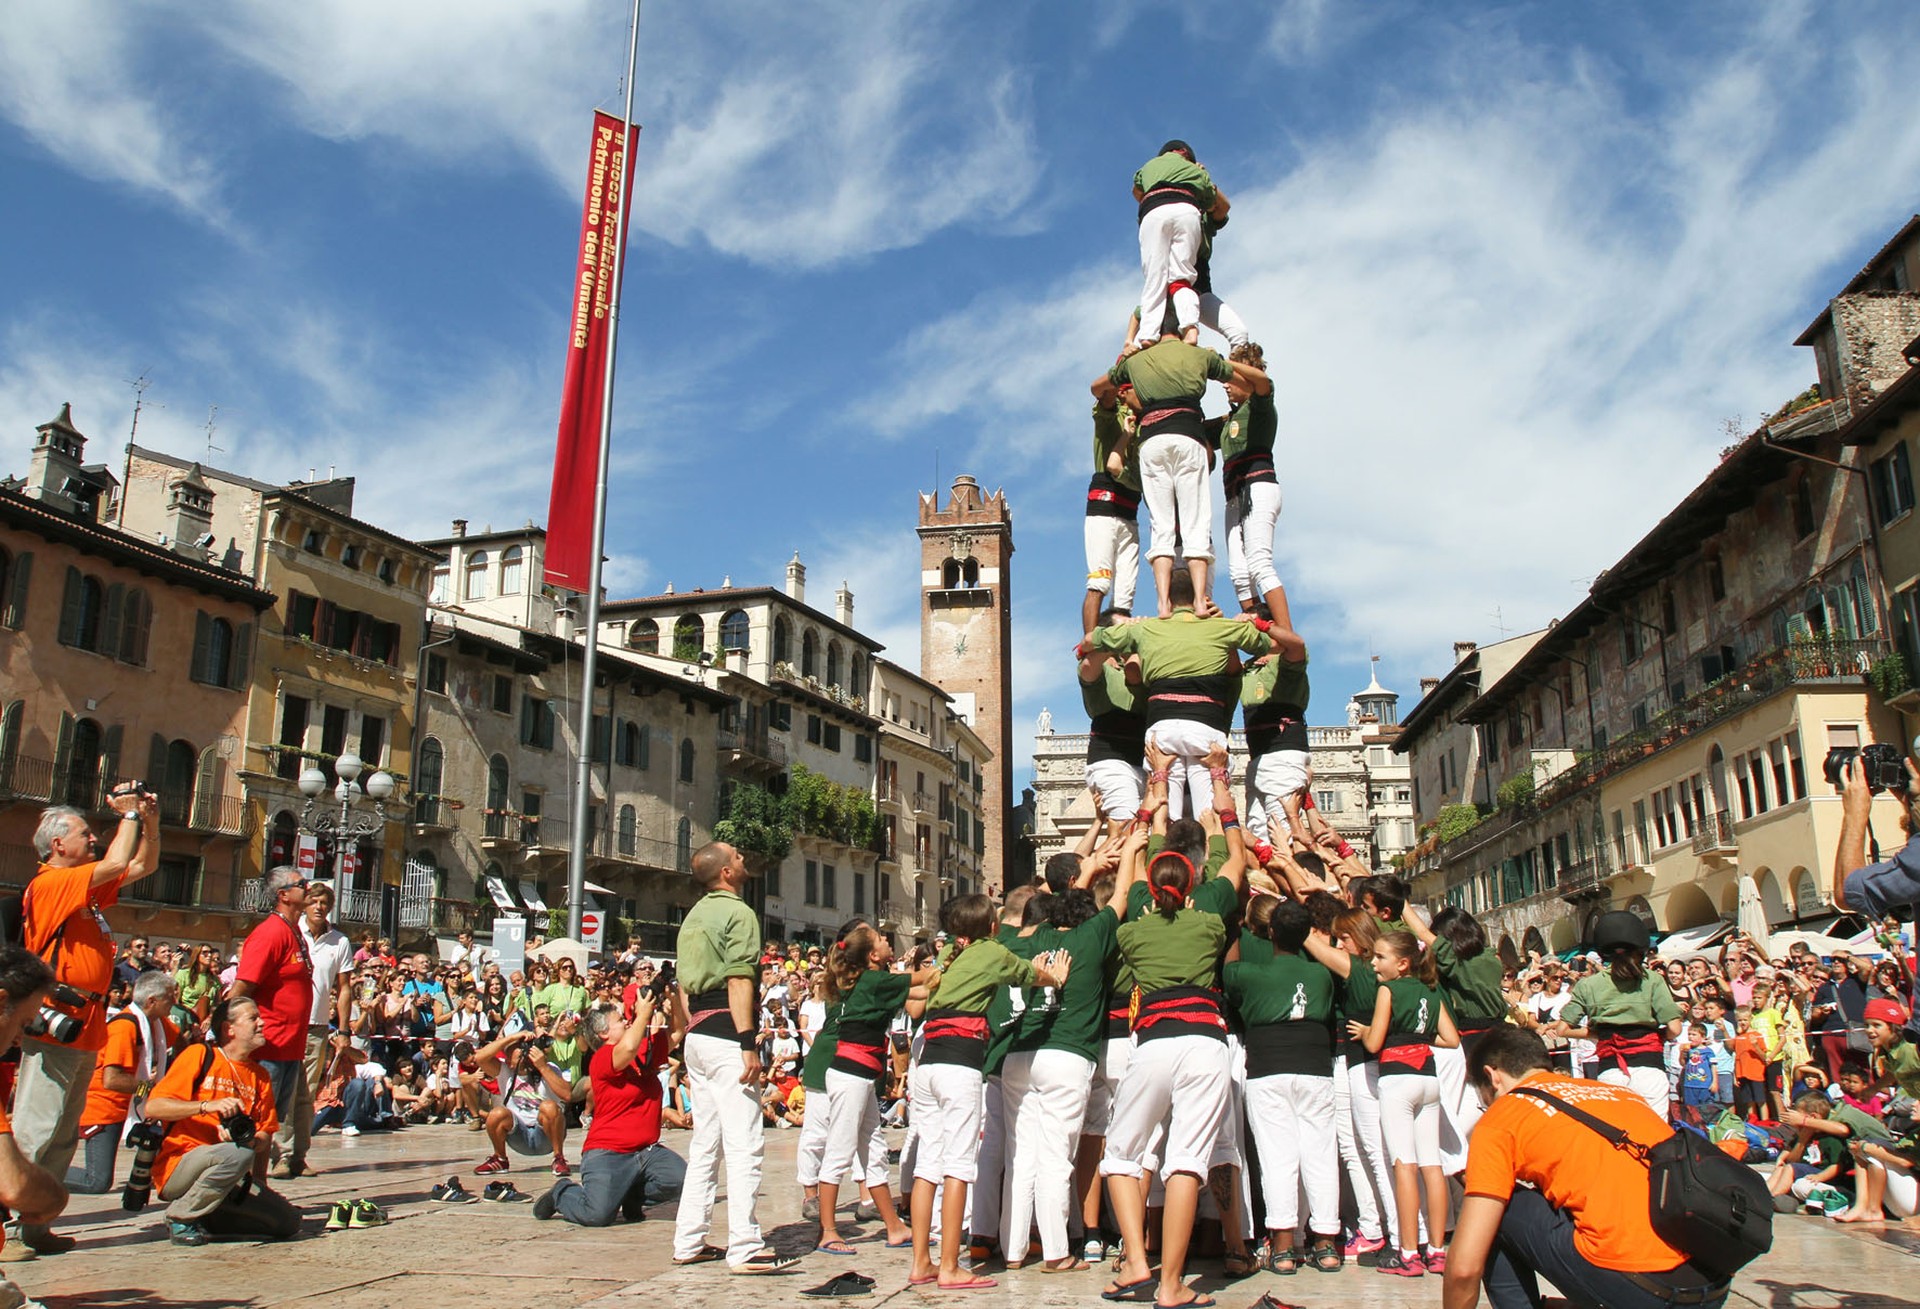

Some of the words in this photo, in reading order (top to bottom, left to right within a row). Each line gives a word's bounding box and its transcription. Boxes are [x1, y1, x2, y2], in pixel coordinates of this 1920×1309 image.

[588, 125, 613, 226] Patrimonio
[608, 151, 624, 204] Gioco
[574, 230, 600, 349] dell'Umanità
[594, 210, 619, 320] Tradizionale
